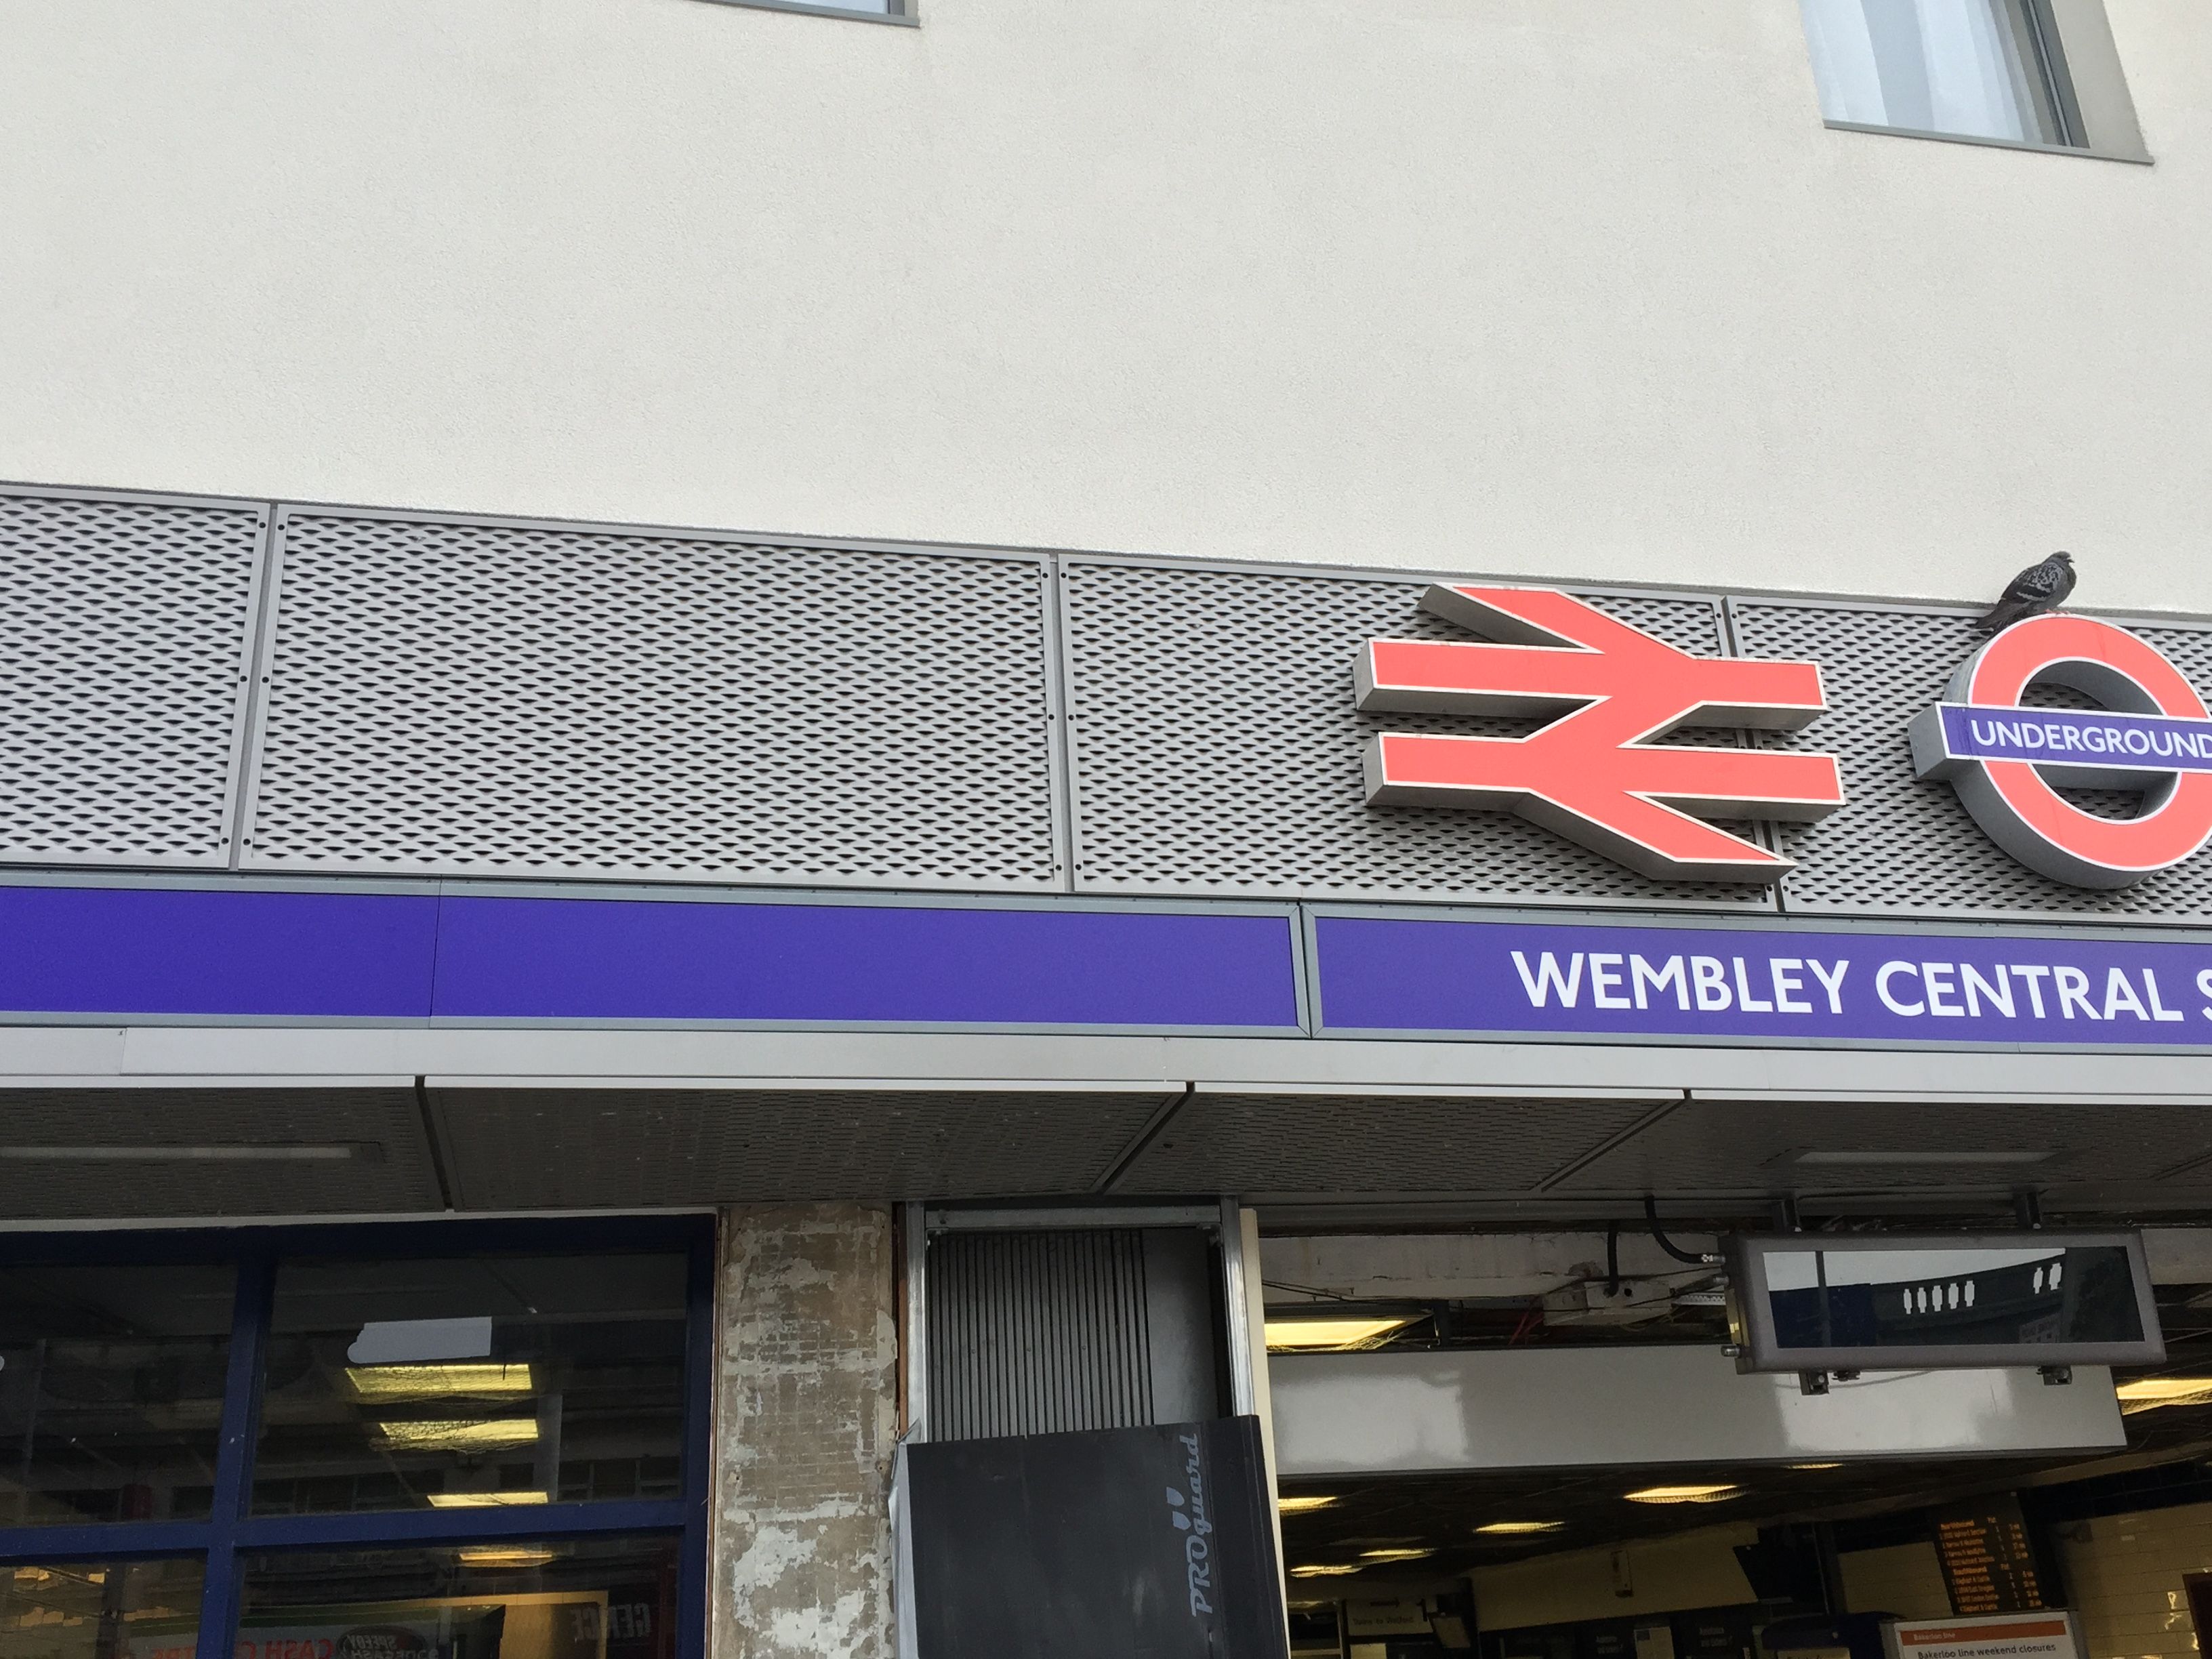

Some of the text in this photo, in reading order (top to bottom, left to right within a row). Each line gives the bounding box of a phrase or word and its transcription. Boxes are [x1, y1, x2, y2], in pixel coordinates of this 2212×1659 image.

[1971, 720, 2212, 758] UNDERGROUND
[1511, 951, 1849, 1015] WEMBLEY
[1876, 961, 2184, 1022] CENTRAL
[1917, 1643, 2056, 1659] Bakerloo line weekend closures
